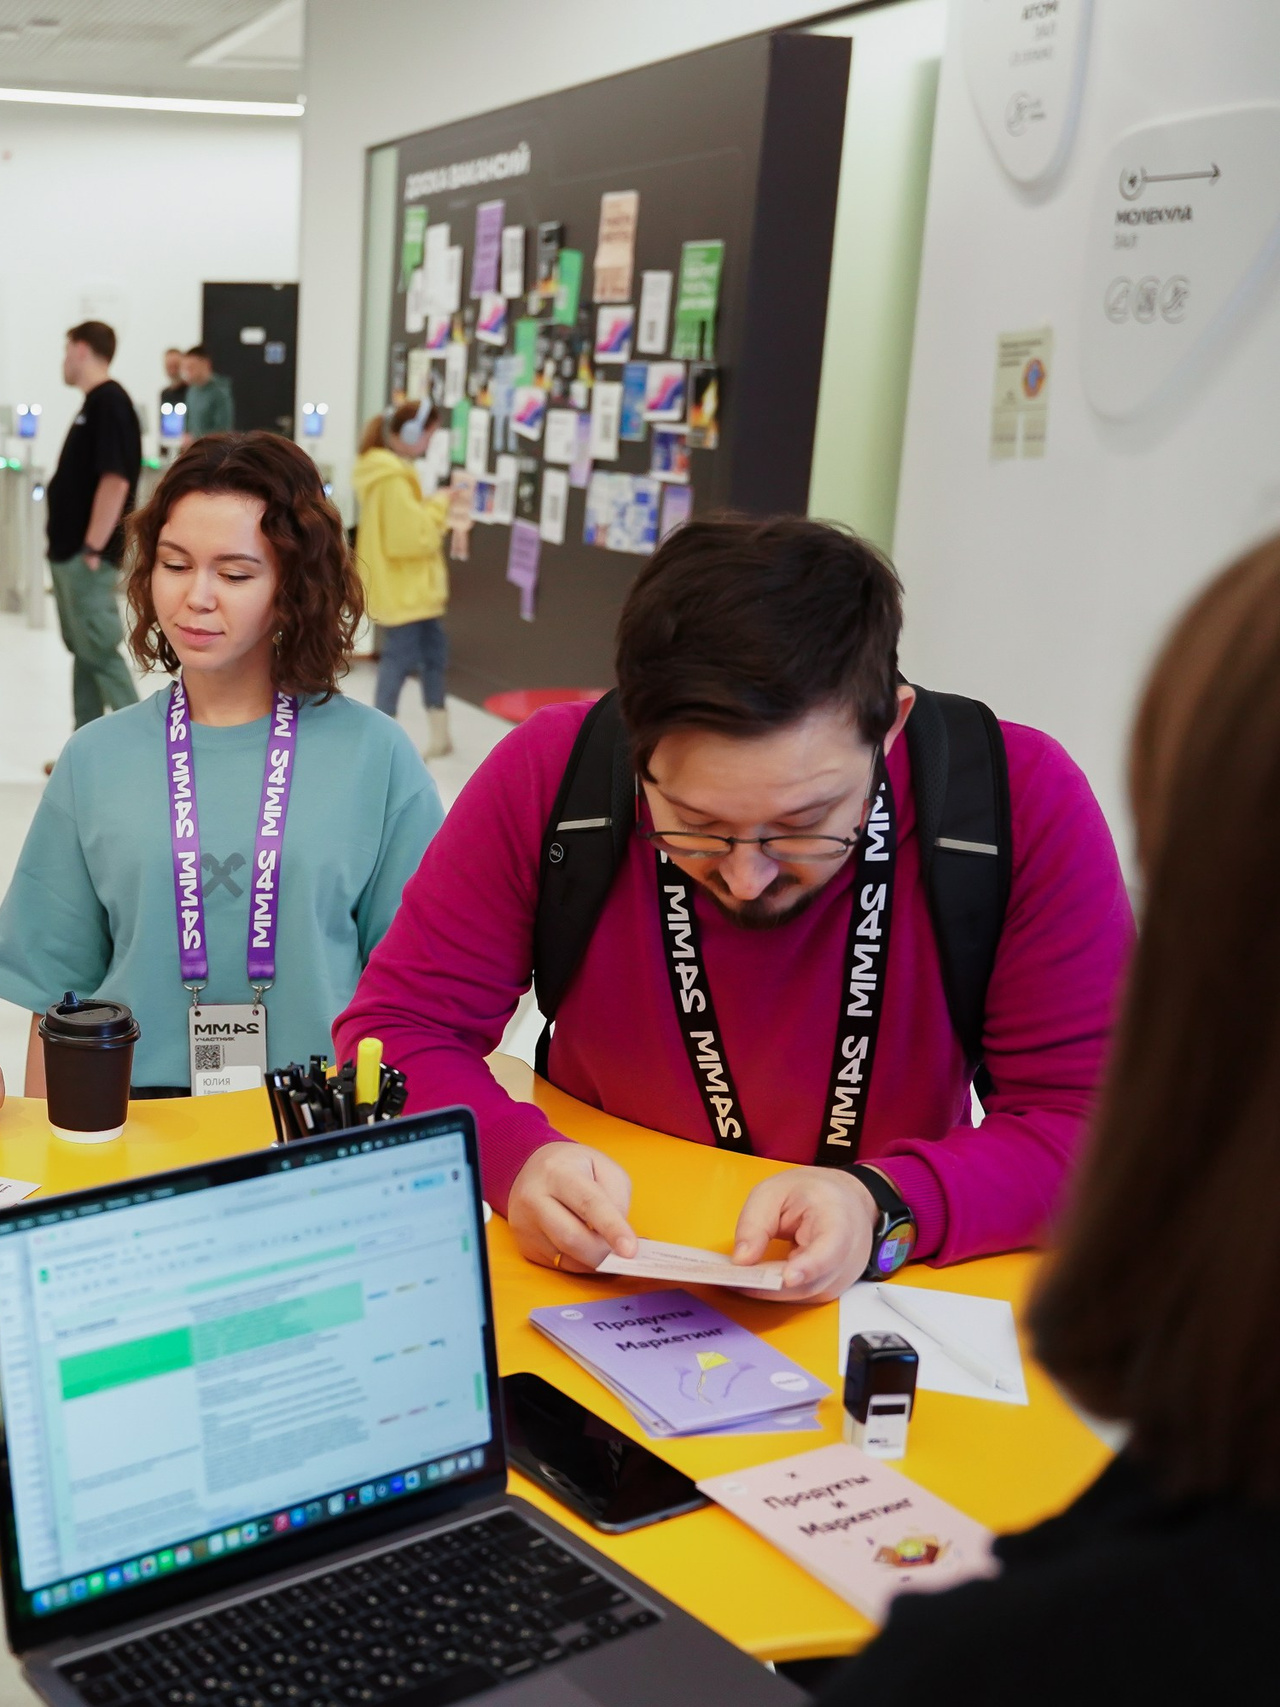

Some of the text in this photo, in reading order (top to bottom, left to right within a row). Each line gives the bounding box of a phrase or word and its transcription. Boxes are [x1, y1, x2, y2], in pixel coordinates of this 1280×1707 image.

[203, 1078, 231, 1087] ЮЛИЯ
[593, 1310, 694, 1331] Продукты
[651, 1326, 666, 1334] и
[615, 1328, 723, 1352] Маркетинг
[763, 1475, 871, 1509] Продукты
[798, 1498, 913, 1537] Маркетинг
